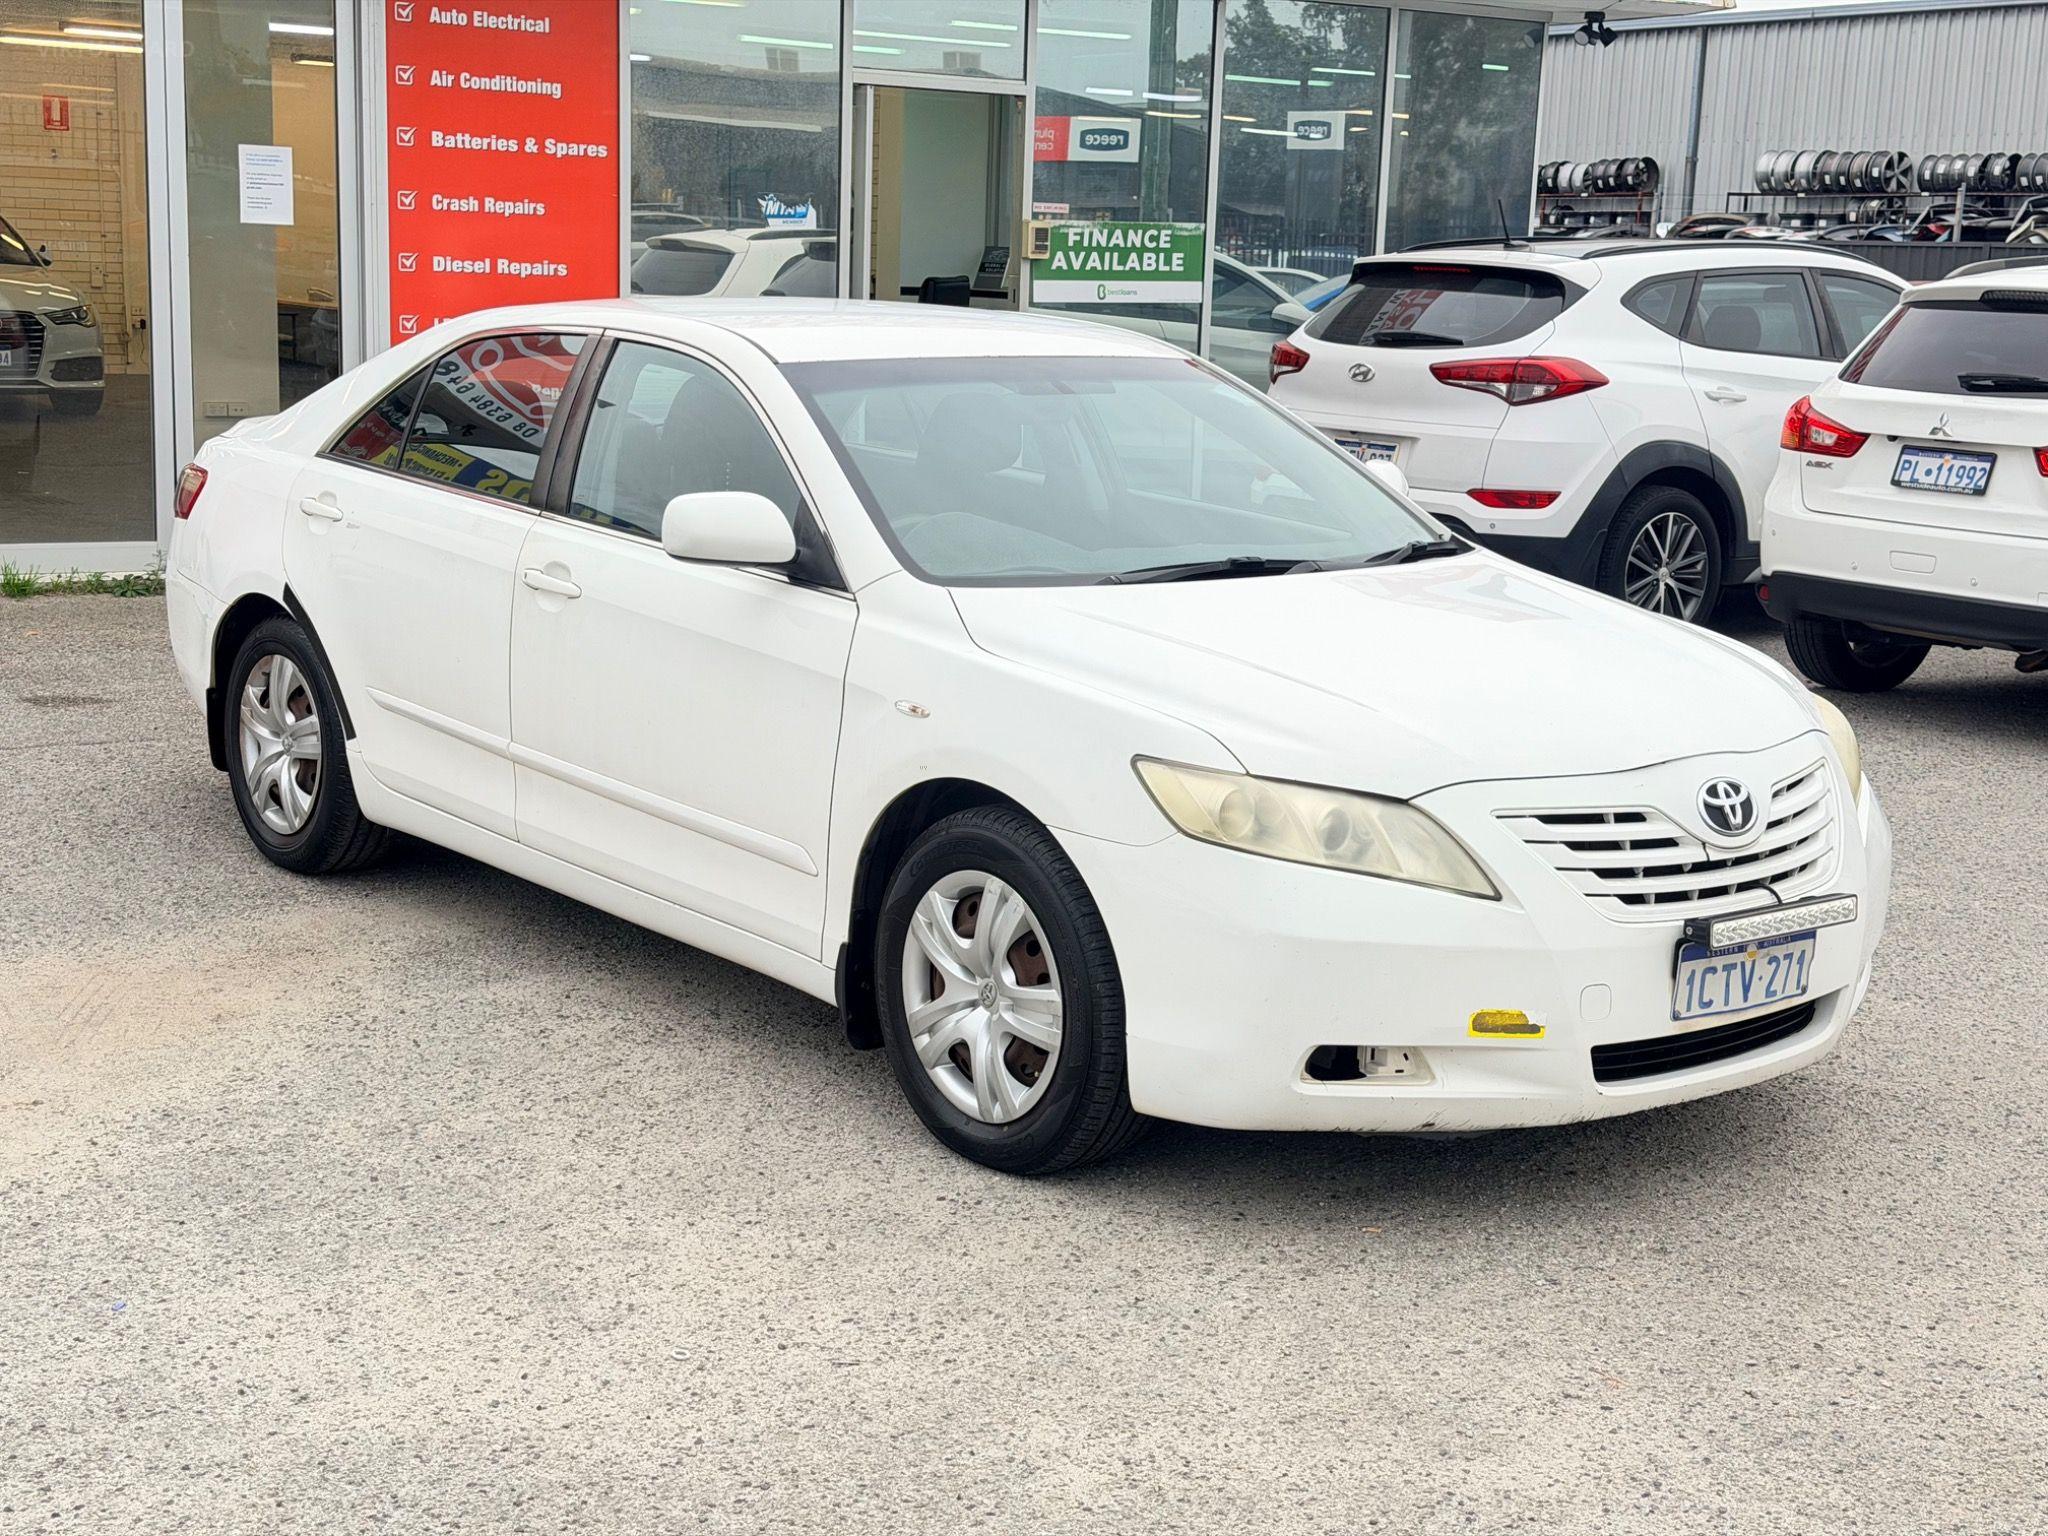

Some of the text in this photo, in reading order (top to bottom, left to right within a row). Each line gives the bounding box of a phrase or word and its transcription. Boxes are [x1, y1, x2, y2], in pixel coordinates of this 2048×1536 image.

[429, 7, 551, 34] Auto Electrical
[430, 70, 562, 99] Air Conditioning
[431, 131, 609, 159] Batteries & Spares
[432, 194, 546, 217] Crash Repairs
[1067, 229, 1172, 249] FINANCE
[433, 256, 568, 278] Diesel Repairs
[1051, 252, 1185, 272] AVAILABLE
[1805, 460, 1835, 471] ASX
